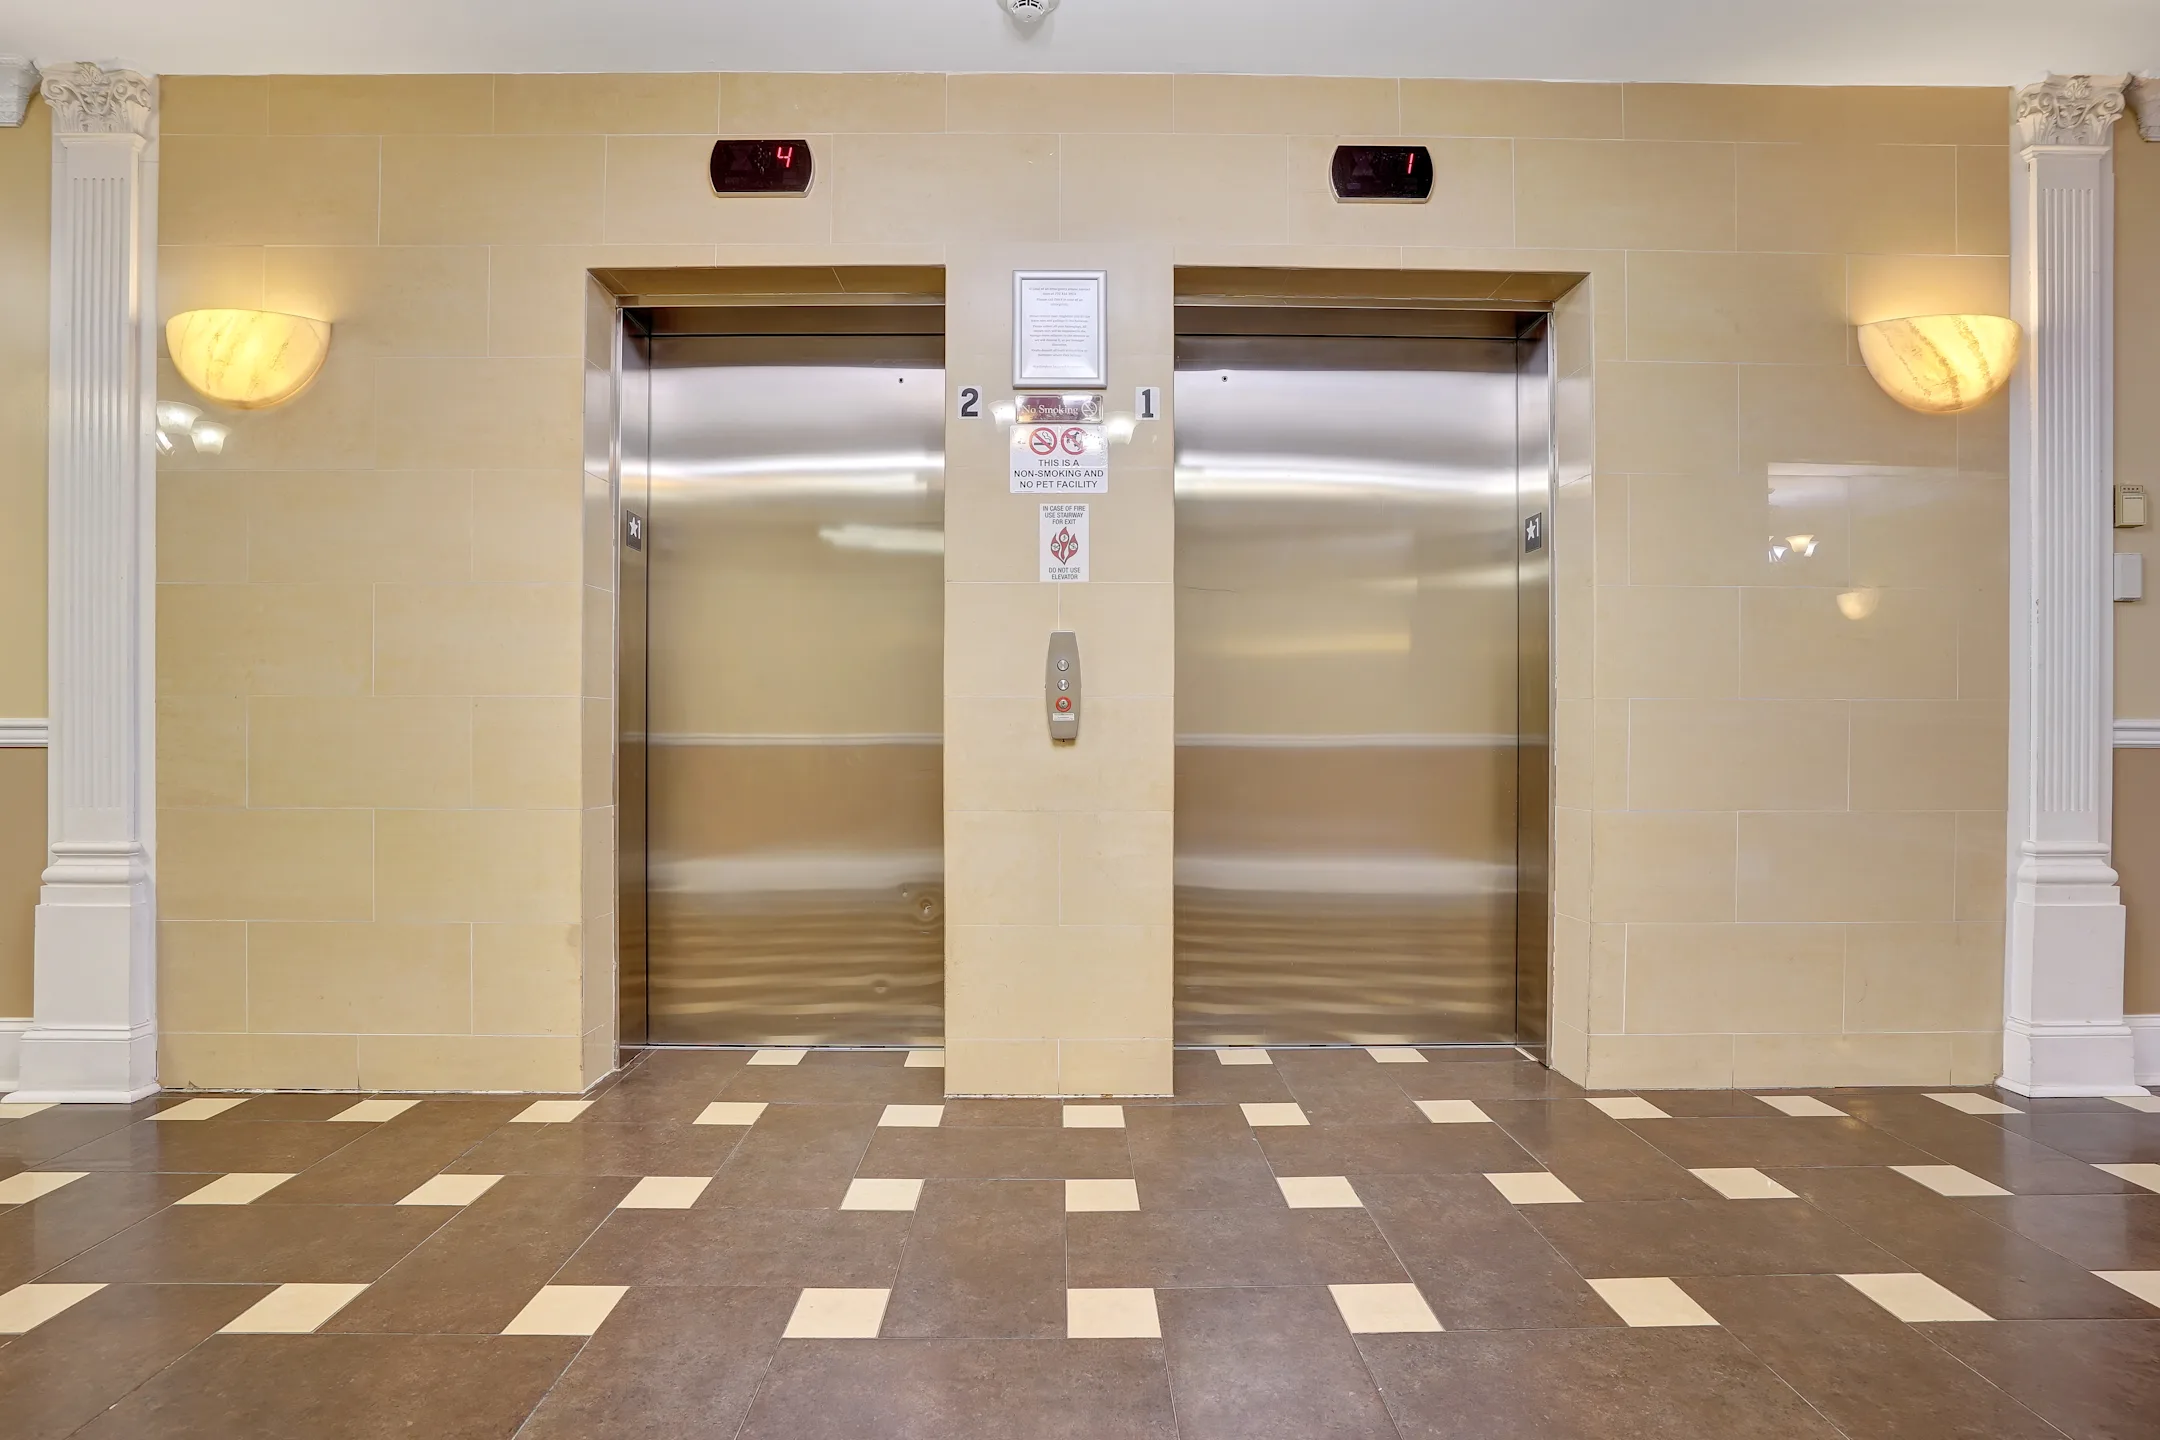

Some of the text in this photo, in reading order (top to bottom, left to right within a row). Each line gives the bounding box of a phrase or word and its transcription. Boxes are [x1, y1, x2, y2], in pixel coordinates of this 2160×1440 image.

[776, 146, 793, 168] 4
[1407, 152, 1414, 175] 1
[960, 387, 979, 417] 2
[1022, 404, 1079, 415] No Smoking
[1141, 388, 1154, 418] 1
[1038, 459, 1080, 467] THIS IS A
[1014, 470, 1104, 478] NON-SMOKING AND
[1019, 480, 1098, 488] NO PET FACILITY
